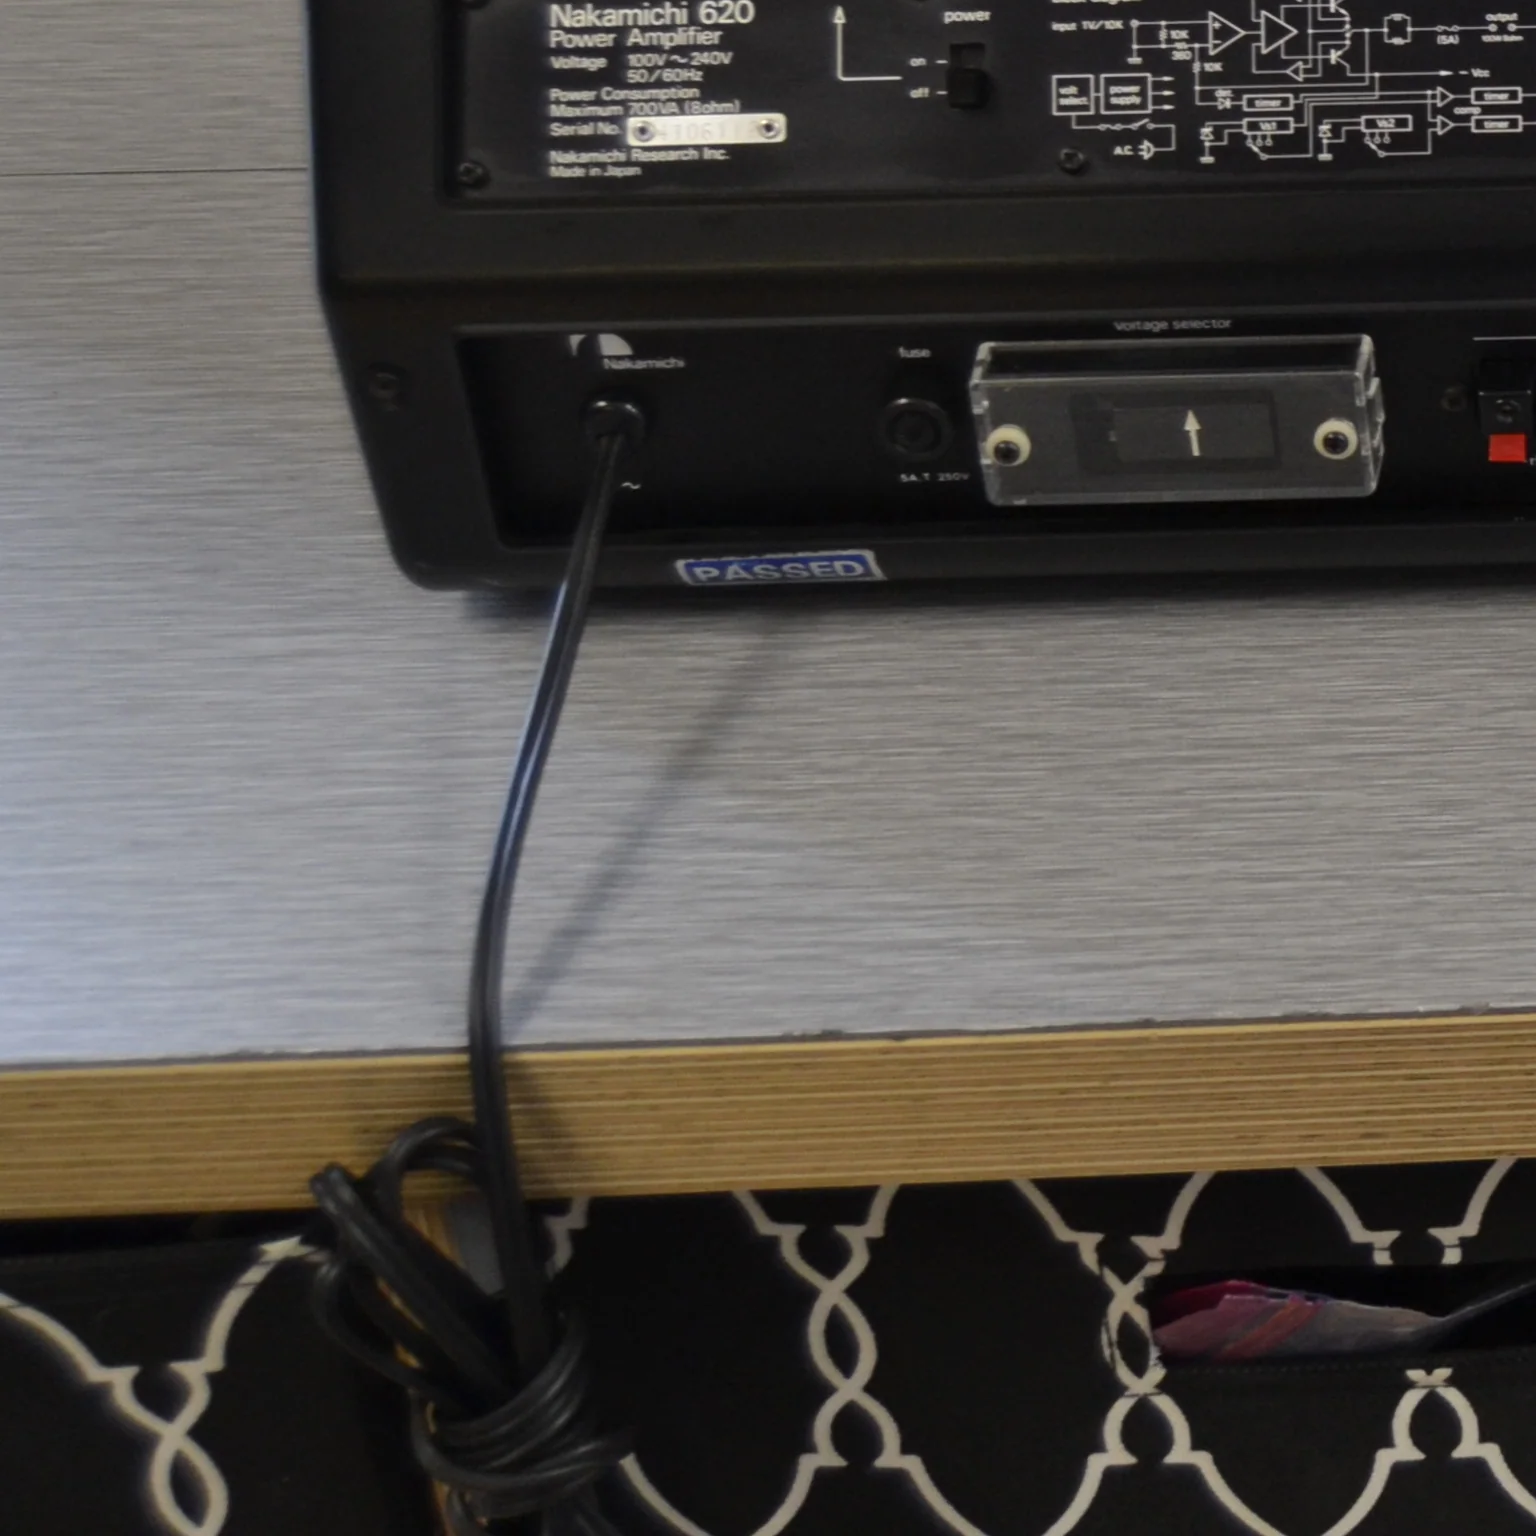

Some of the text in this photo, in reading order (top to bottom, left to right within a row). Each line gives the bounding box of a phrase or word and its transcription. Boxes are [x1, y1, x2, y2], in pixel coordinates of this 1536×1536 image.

[550, 1, 689, 27] Nakamichi
[943, 10, 992, 24] power
[1485, 13, 1519, 24] output
[550, 26, 723, 50] Power Amplifier
[551, 56, 609, 71] Voltage
[550, 86, 701, 102] Power Consumption
[550, 105, 624, 117] Maximum
[550, 122, 594, 136] Serial
[550, 146, 731, 164] Nakamichi Research Inc.
[550, 165, 643, 178] Made in Japan
[1113, 319, 1232, 333] voltage selector
[899, 347, 932, 358] fuse
[692, 561, 865, 582] PASSED
